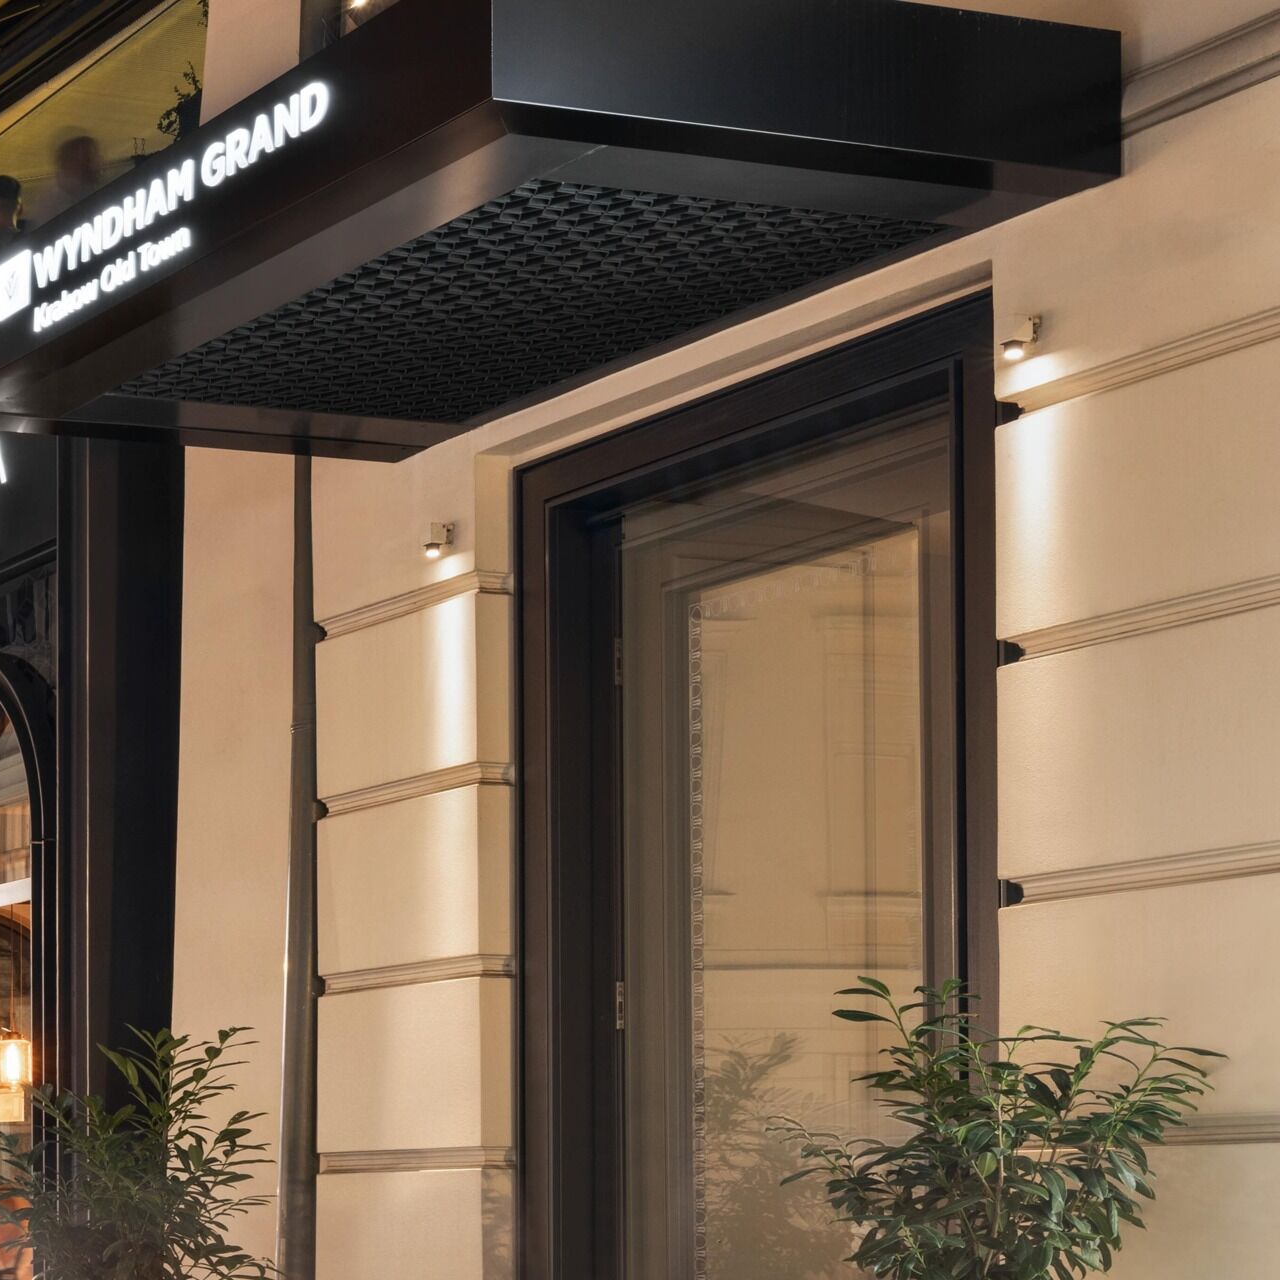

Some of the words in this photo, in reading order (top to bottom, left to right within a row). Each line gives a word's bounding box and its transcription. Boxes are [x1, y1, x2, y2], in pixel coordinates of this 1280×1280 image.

[32, 158, 196, 290] WYNDHAM
[200, 81, 330, 188] GRAND
[32, 279, 101, 333] Krakow
[100, 249, 137, 293] Old
[137, 226, 192, 272] Town
